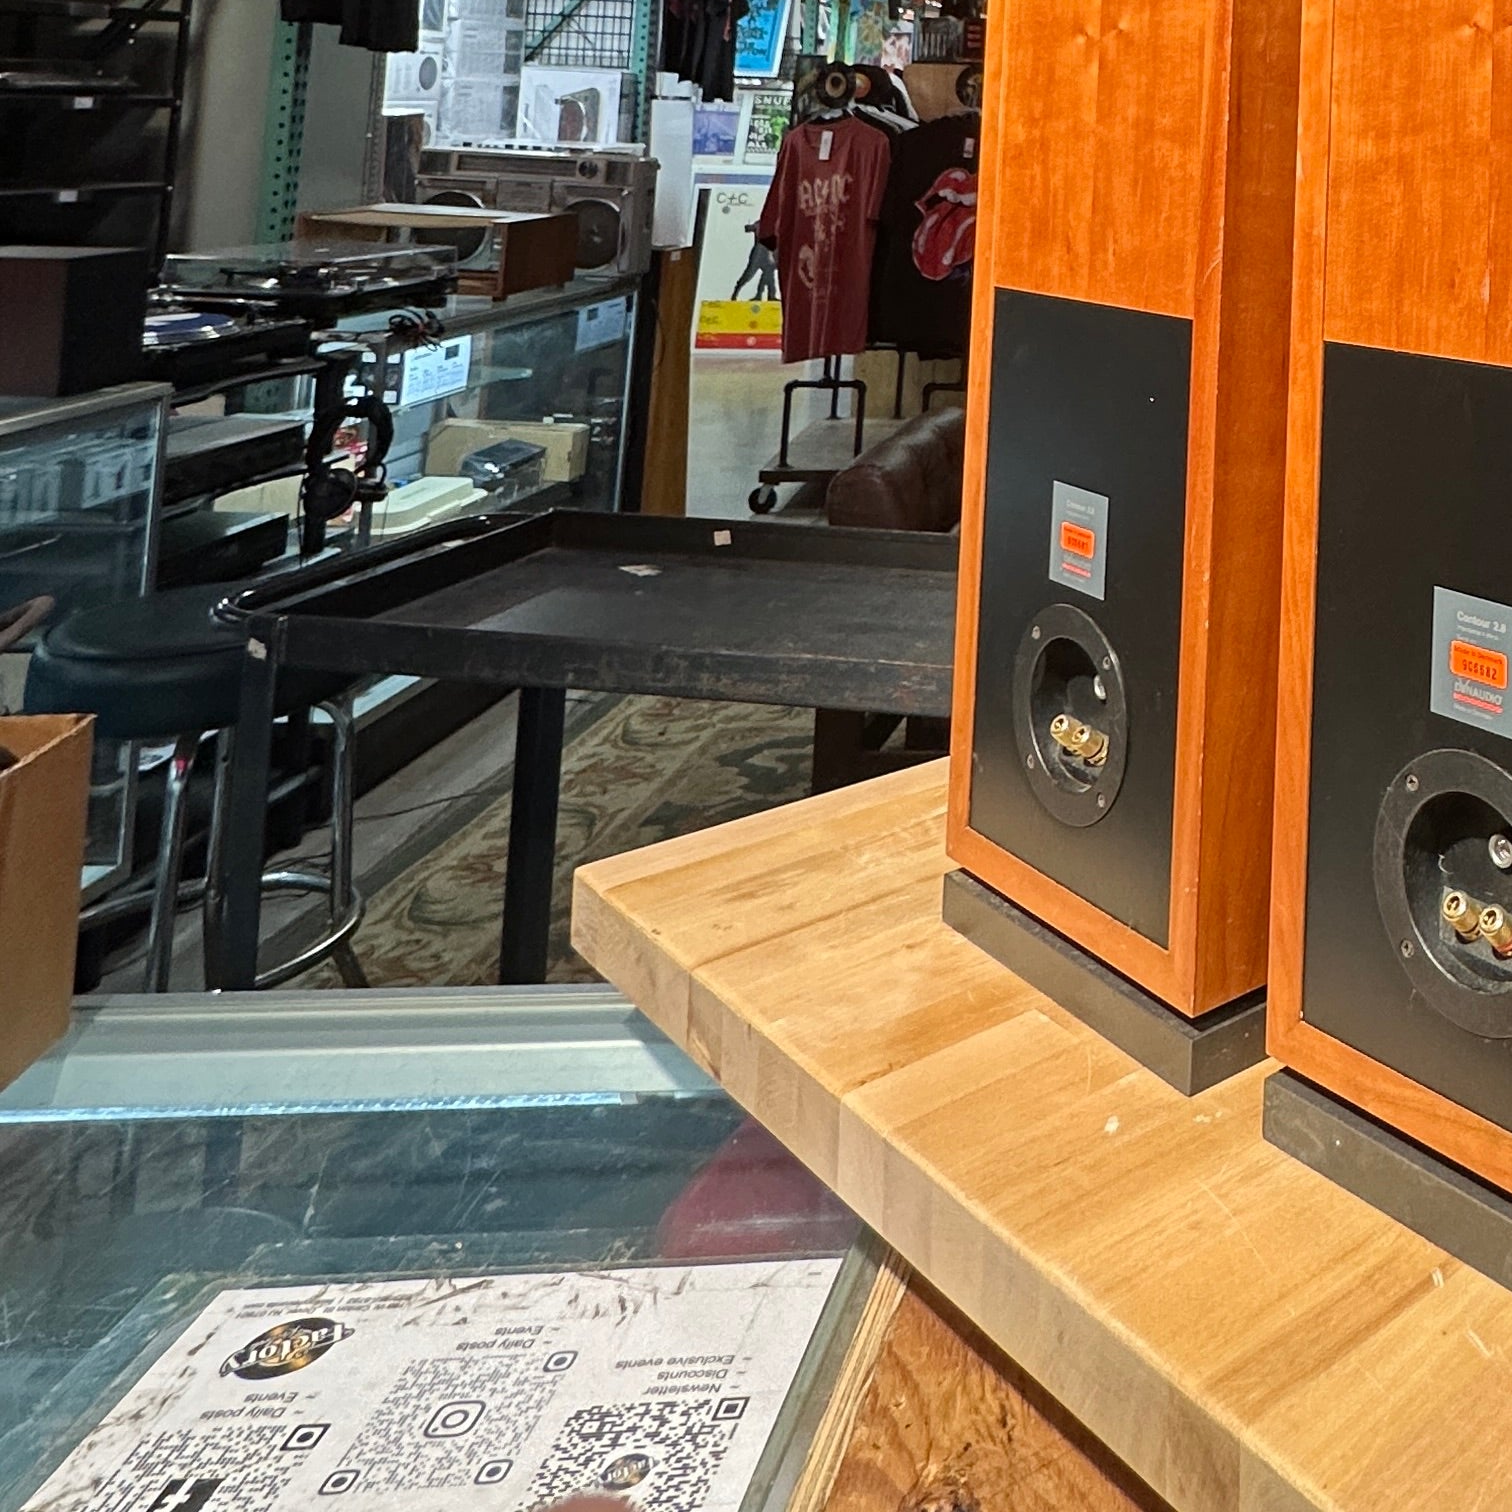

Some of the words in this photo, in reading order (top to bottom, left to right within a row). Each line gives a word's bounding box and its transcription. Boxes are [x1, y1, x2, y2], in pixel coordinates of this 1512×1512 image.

[494, 1325, 545, 1335] Events
[222, 1323, 345, 1371] Factory
[456, 1339, 498, 1351] posts
[498, 1339, 535, 1349] Daily
[615, 1358, 663, 1369] events
[666, 1355, 736, 1367] Exclusive
[657, 1369, 729, 1381] Discounts
[642, 1383, 722, 1396] Newsletter
[244, 1392, 299, 1403] Events
[200, 1407, 246, 1420] posts
[246, 1407, 287, 1419] Daily
